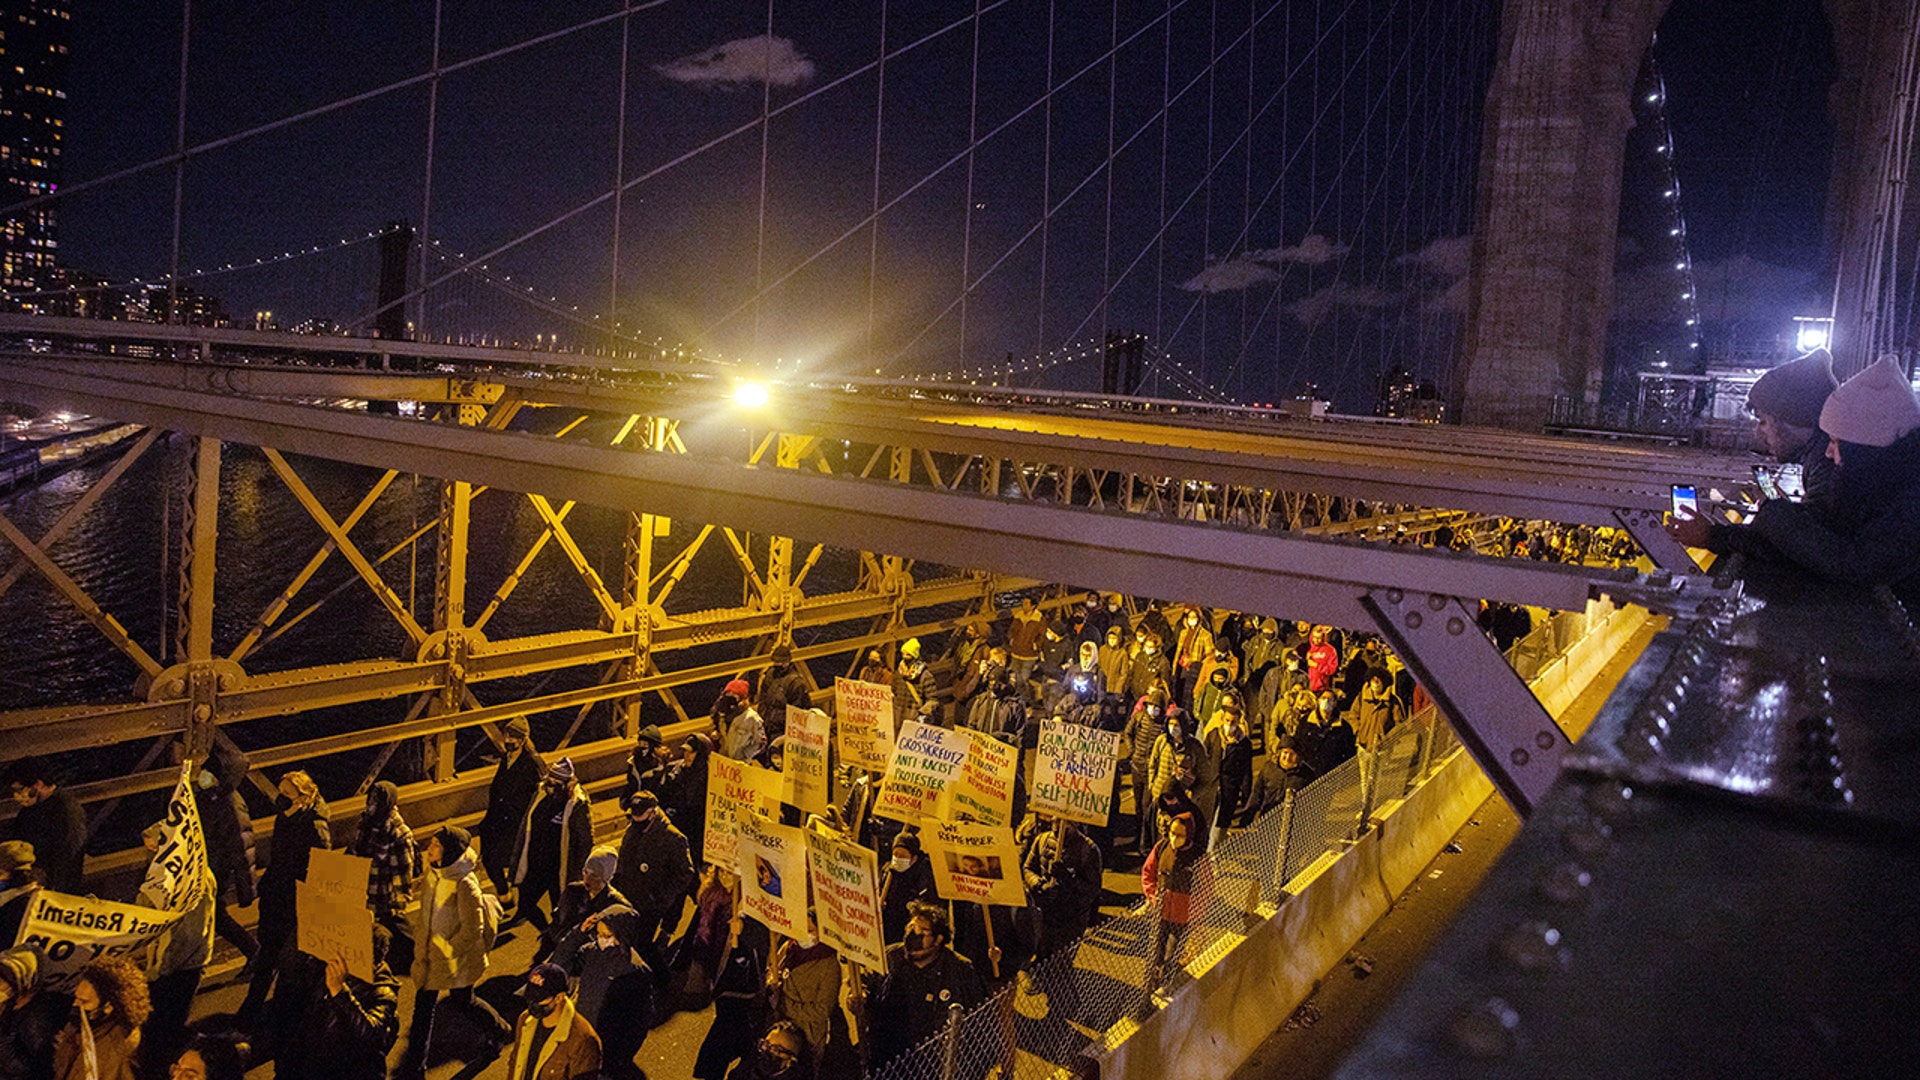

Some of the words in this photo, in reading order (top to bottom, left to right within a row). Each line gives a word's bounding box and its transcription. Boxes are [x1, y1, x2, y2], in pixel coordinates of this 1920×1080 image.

[838, 680, 852, 695] FOR
[852, 683, 892, 702] WORKERS
[846, 696, 882, 712] DEFENSE
[1042, 721, 1056, 731] NO
[1063, 724, 1076, 735] TO
[1078, 727, 1118, 744] RACIST
[844, 737, 875, 751] FASCIST
[1043, 733, 1067, 747] GUN
[1070, 738, 1118, 757] CONTROL
[1040, 744, 1060, 759] FOR
[1061, 748, 1076, 764] THE
[1081, 754, 1118, 771] RIGHT
[714, 761, 742, 784] JACOB
[1050, 759, 1063, 770] OF
[1065, 762, 1105, 779] ARMED
[894, 768, 944, 792] PROTESTER
[1055, 772, 1092, 793] BLACK
[725, 783, 755, 803] BLAKE
[884, 793, 922, 811] KENOSHA
[885, 781, 923, 798] WOUNDED
[927, 789, 938, 802] IN
[1036, 782, 1109, 815] SELF-DEFENSE
[709, 792, 716, 806] 7
[758, 807, 769, 817] IN
[713, 809, 726, 821] THE
[941, 823, 958, 833] WE
[951, 874, 994, 889] ANTHONY
[760, 895, 786, 917] JOSEPH
[306, 929, 367, 968] SYSTEM
